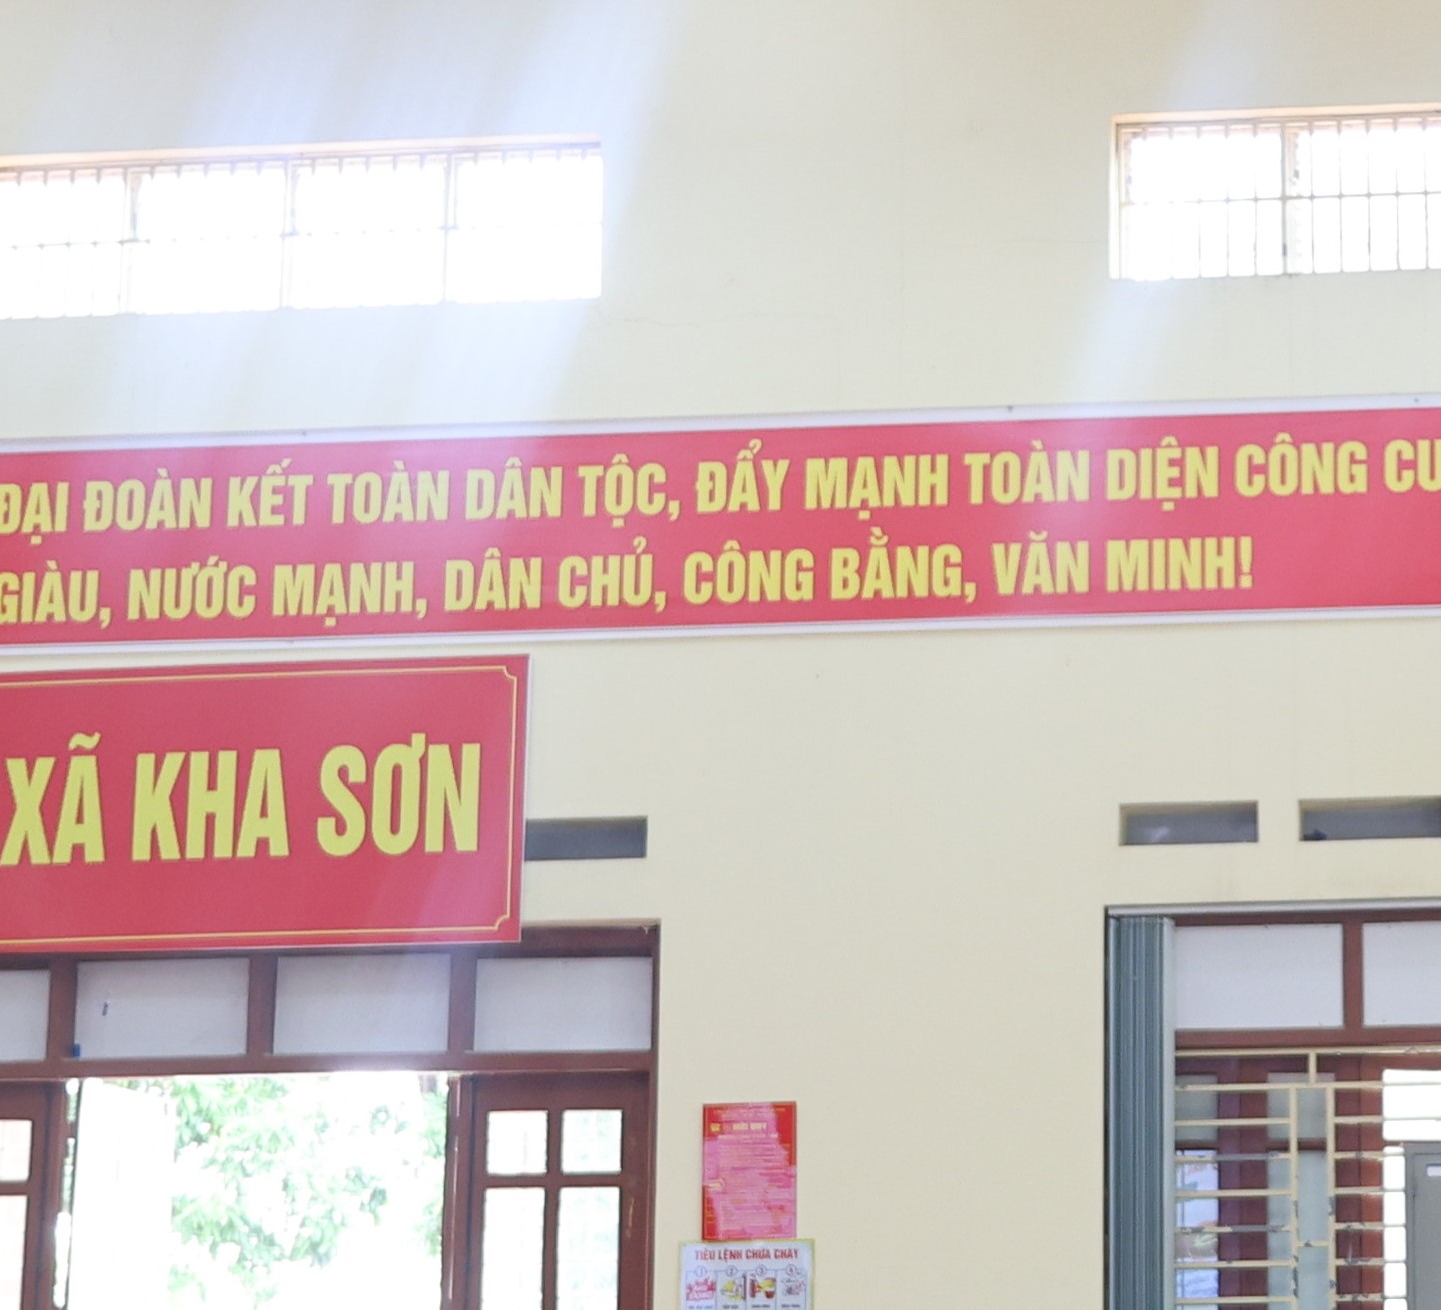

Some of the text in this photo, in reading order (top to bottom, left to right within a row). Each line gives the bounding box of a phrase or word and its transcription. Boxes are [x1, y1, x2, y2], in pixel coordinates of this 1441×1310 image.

[82, 467, 212, 530] ĐOÀN
[226, 458, 316, 528] KẾT
[326, 459, 450, 523] TOÀN
[465, 456, 562, 521] DÂN
[577, 453, 681, 528] TỘC,
[695, 439, 790, 515] ĐẨY
[804, 453, 950, 520] MẠNH
[964, 439, 1090, 506] TOÀN
[1106, 436, 1219, 511] DIỆN
[1234, 432, 1368, 497] CÔNG
[126, 554, 257, 621] NƯỚC
[271, 561, 429, 627] MẠNH,
[443, 548, 543, 614] DÂN
[558, 536, 667, 612] CHỦ,
[683, 540, 814, 605] CÔNG
[830, 527, 978, 604] BẰNG,
[991, 530, 1090, 596] VĂN
[1106, 536, 1253, 593] MINH!
[0, 731, 481, 866] XÃ KHA SƠN
